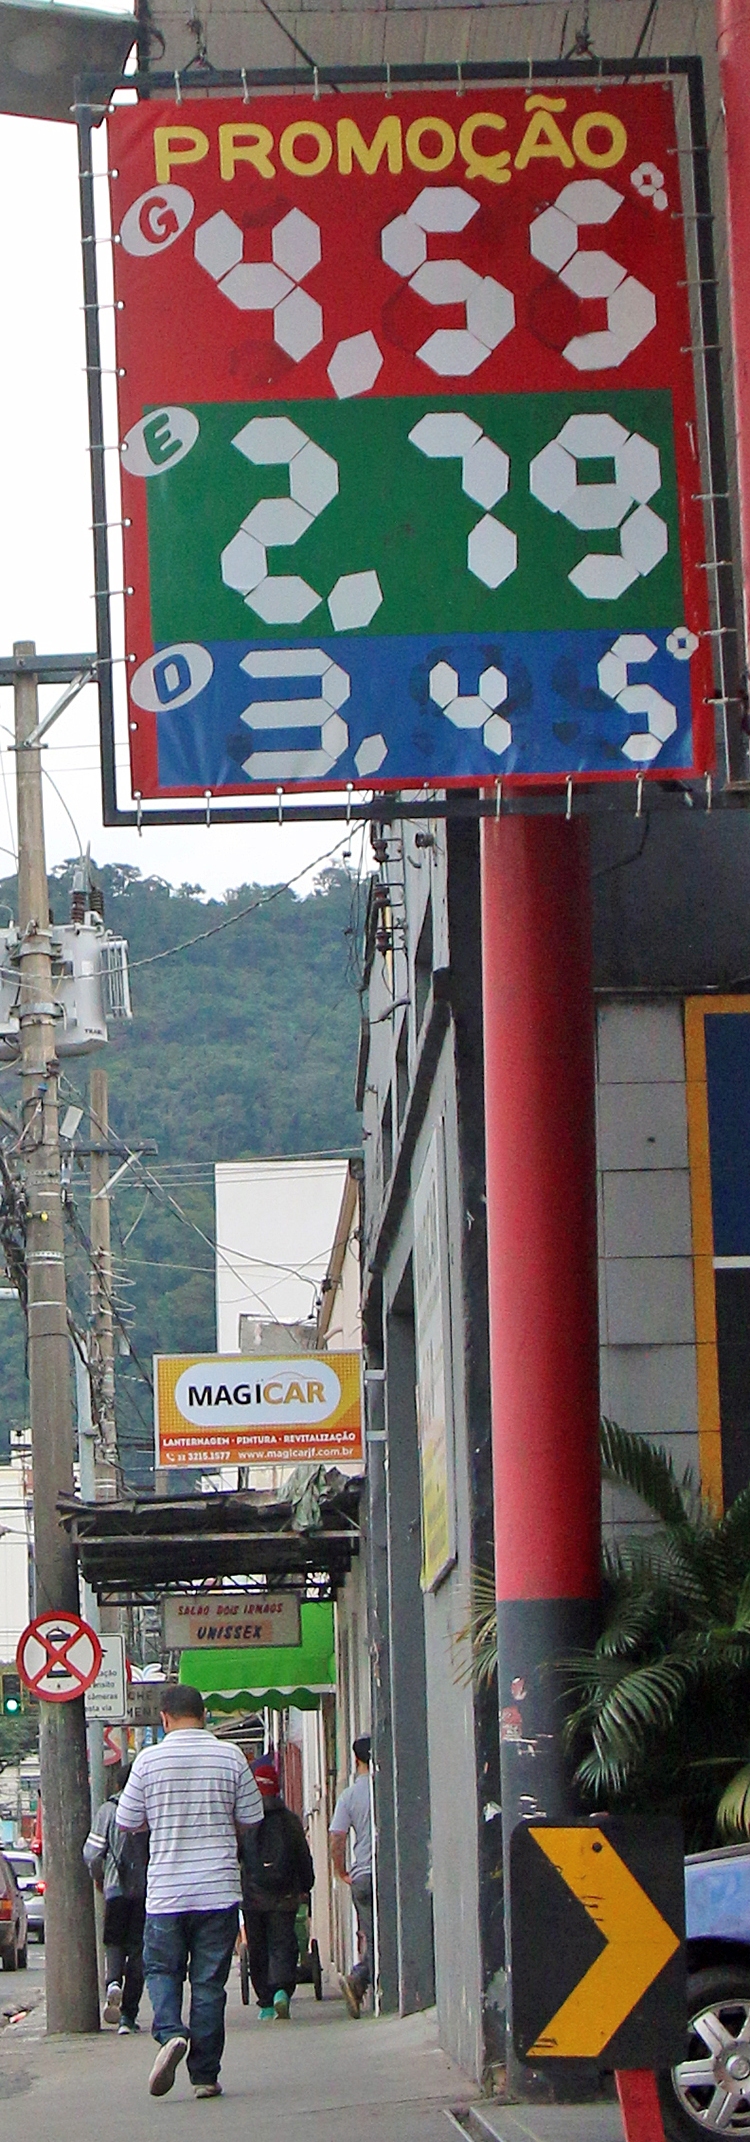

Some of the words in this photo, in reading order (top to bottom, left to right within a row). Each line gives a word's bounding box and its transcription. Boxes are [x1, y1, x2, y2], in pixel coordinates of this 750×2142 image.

[153, 95, 627, 184] PROMOÇÃO
[139, 196, 180, 244] G
[143, 413, 184, 466] E
[152, 652, 192, 704] D
[187, 1381, 326, 1406] MAGICAR
[162, 1437, 230, 1447] LANTERNAGEM
[236, 1435, 277, 1444] PINTURA
[283, 1431, 356, 1443] REVITALIZAÇÃO
[196, 1624, 263, 1640] UNISSEX
